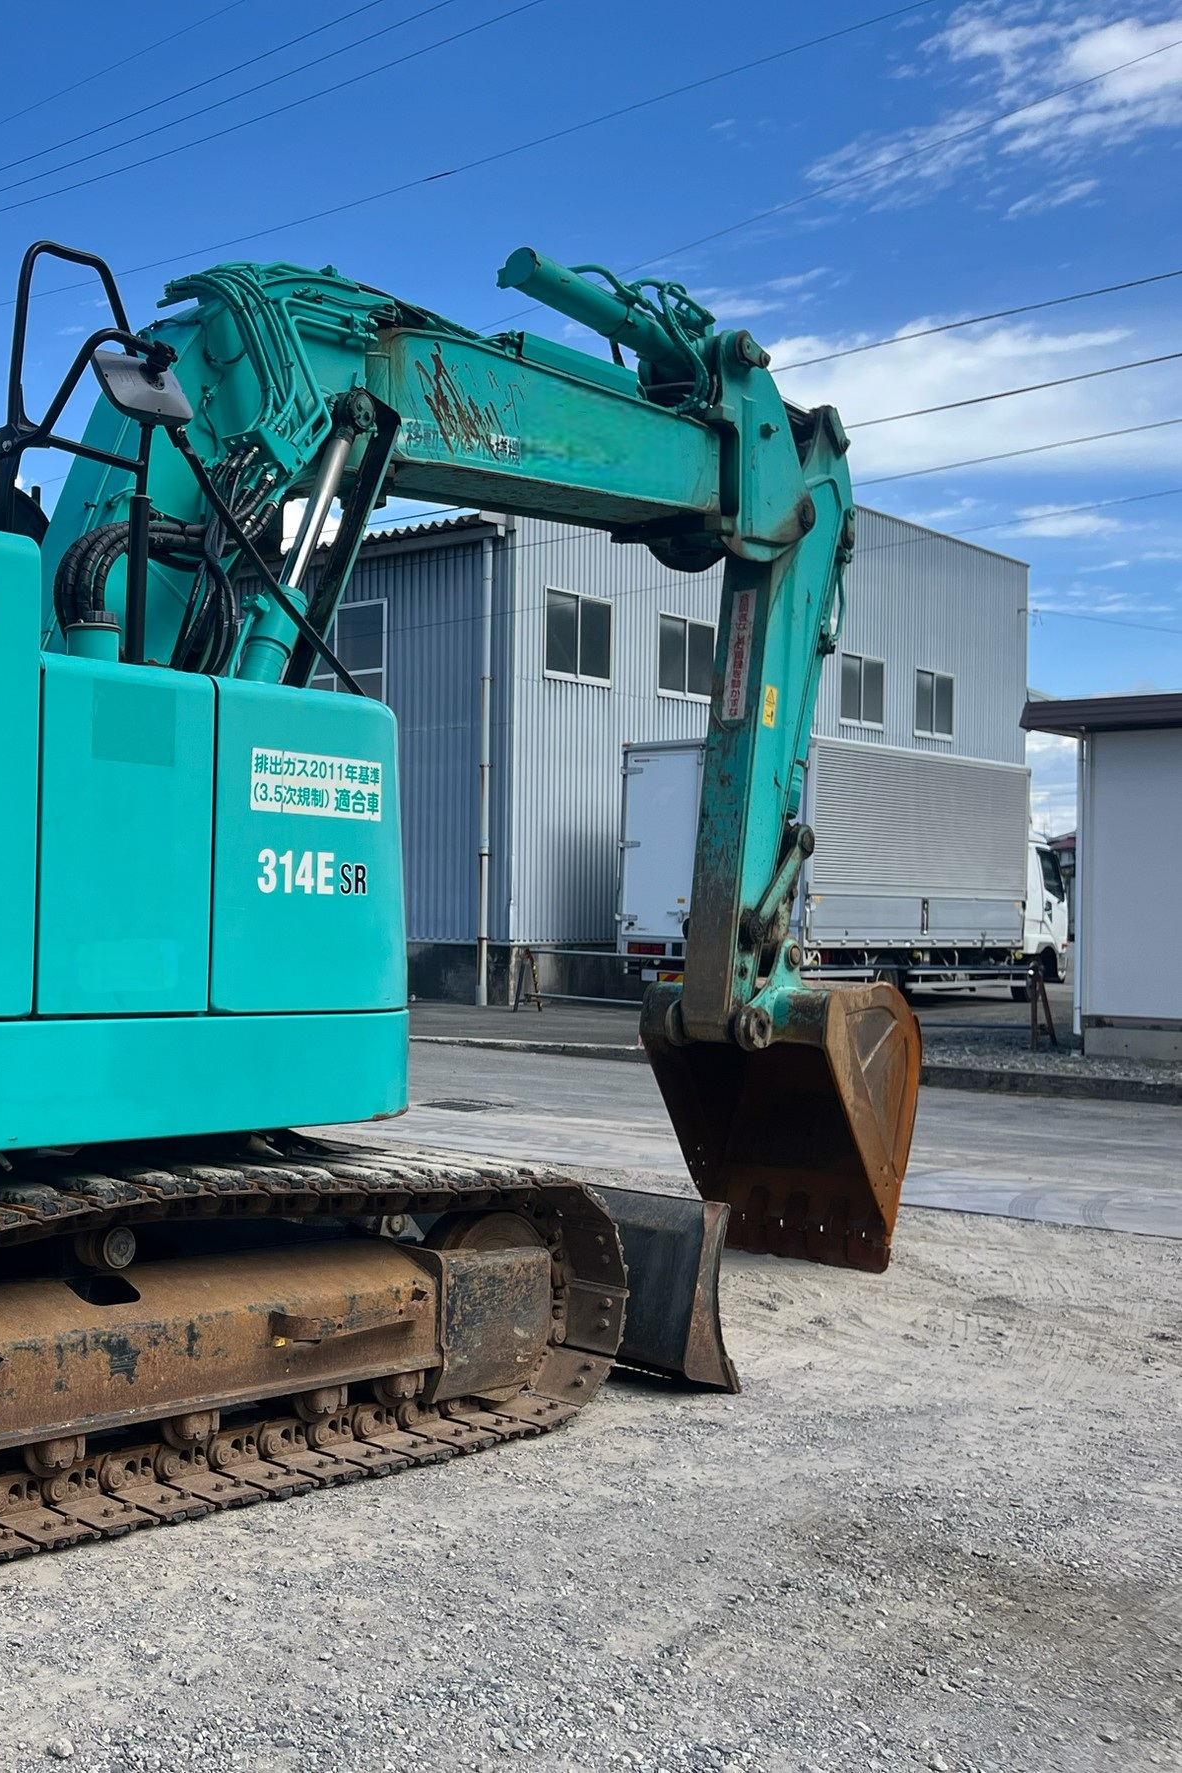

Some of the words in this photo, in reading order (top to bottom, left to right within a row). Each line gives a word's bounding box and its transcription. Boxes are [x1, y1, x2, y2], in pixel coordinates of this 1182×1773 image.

[254, 753, 380, 786] 排出ガス2011年基準
[257, 848, 335, 895] 314E
[339, 862, 368, 895] SR
